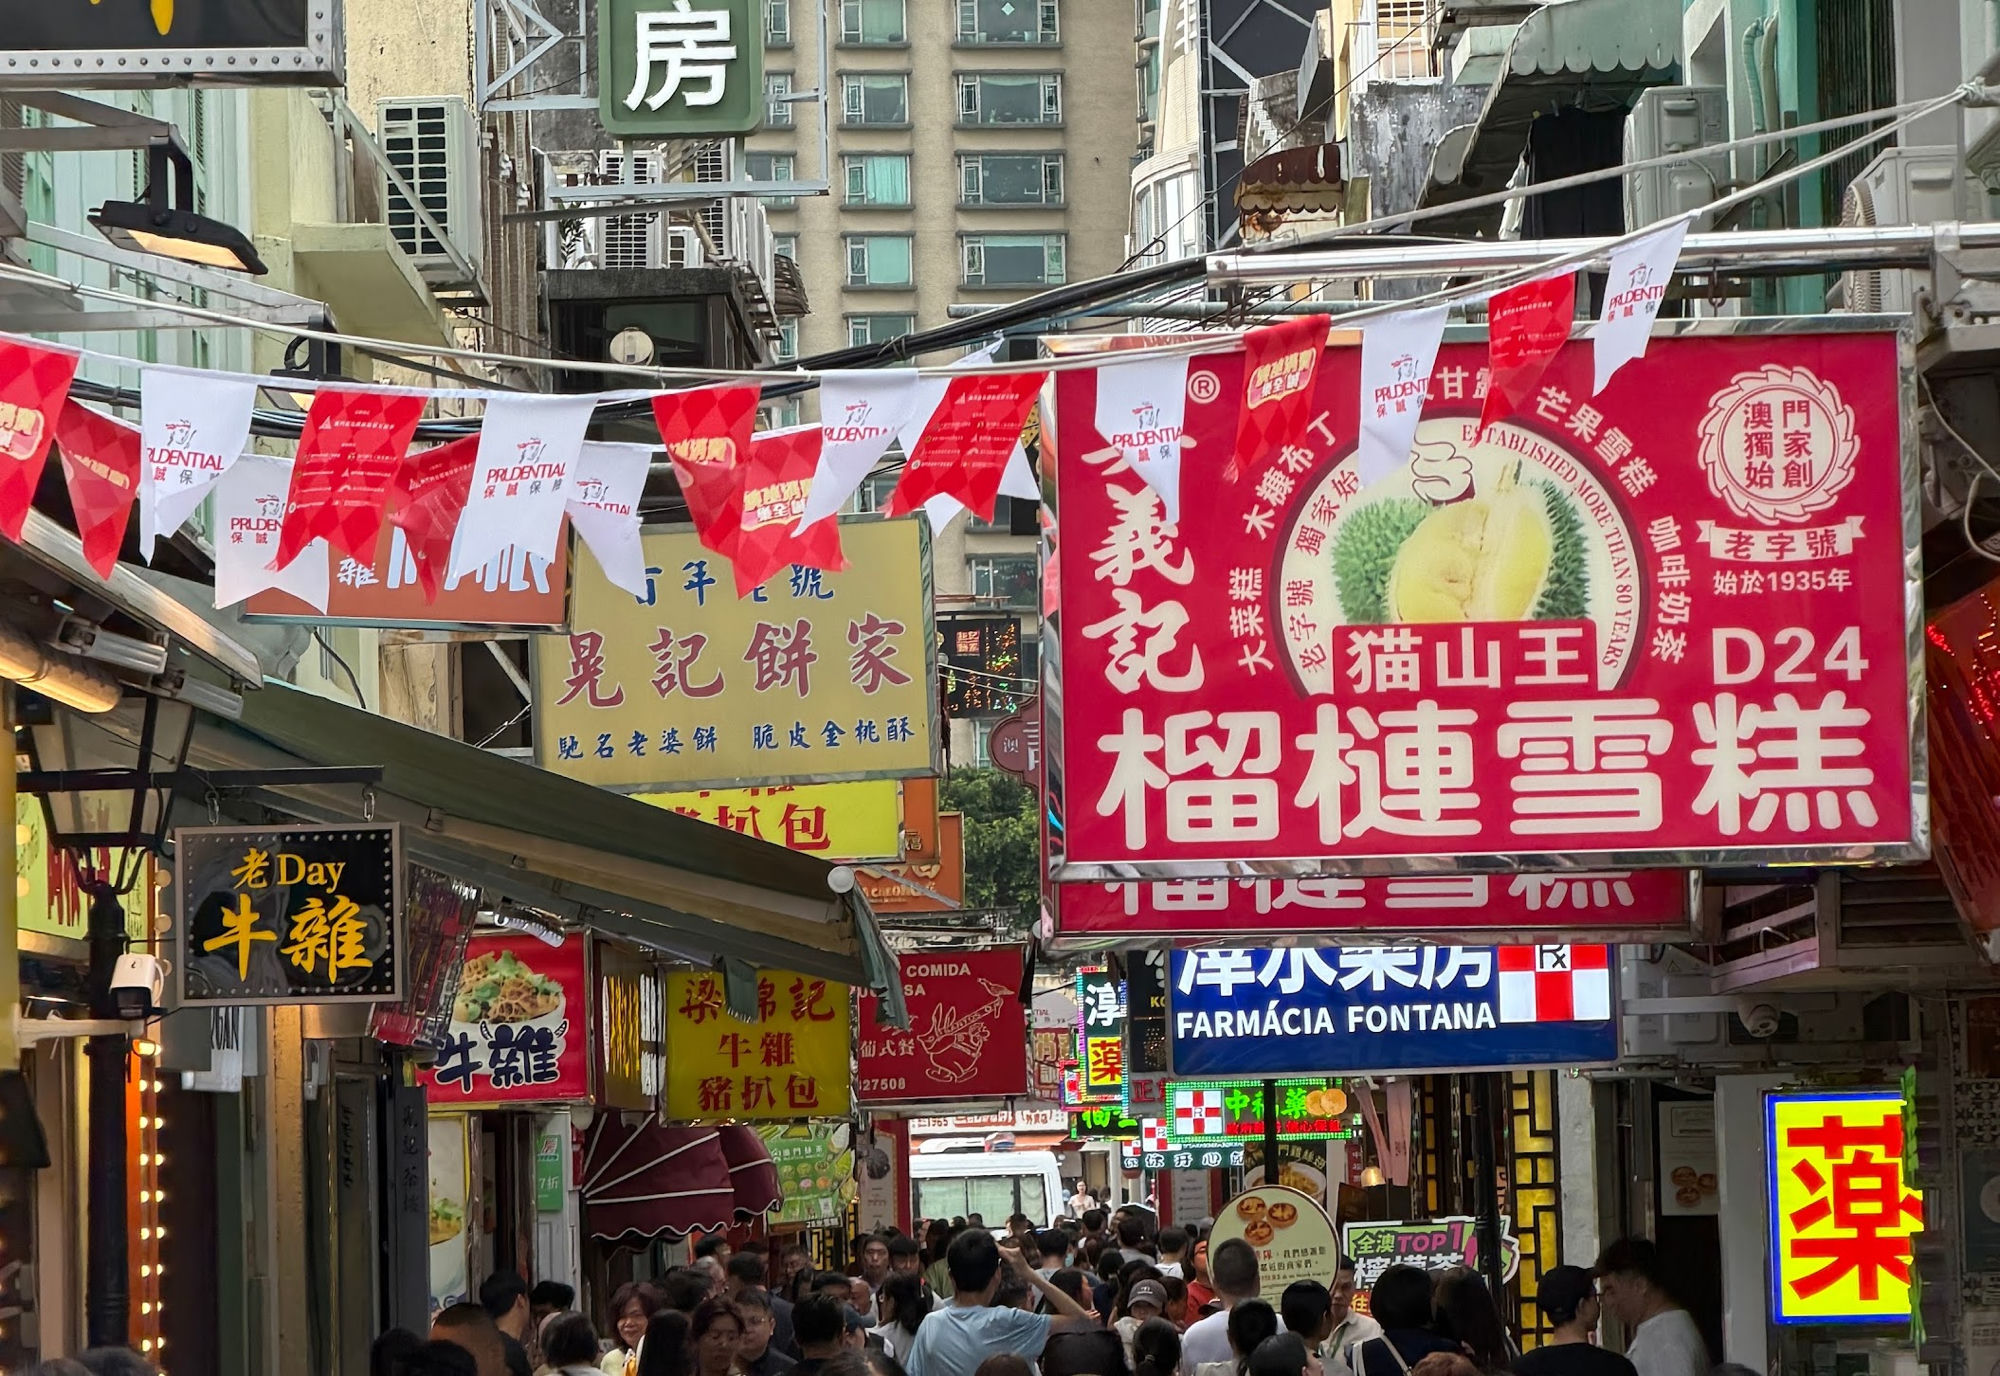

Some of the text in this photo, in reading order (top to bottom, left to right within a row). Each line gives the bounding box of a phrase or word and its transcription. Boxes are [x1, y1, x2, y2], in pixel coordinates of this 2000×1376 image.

[623, 0, 737, 112] 房
[1744, 400, 1811, 430] 澳門
[1536, 386, 1659, 498] 芒果雪糕
[1744, 431, 1812, 458] 獨家
[487, 462, 566, 484] PRUDENTIAL
[1243, 411, 1336, 540] 木糠布丁
[1744, 461, 1814, 489] 始創
[1574, 479, 1614, 528] MORE
[1603, 527, 1633, 580] THAN
[1724, 530, 1839, 561] 老字號
[1615, 581, 1634, 606] 80
[1647, 515, 1692, 665] 咖啡奶茶
[1713, 568, 1853, 596] 始於1935年
[1228, 567, 1275, 677] 大菜糕
[1287, 580, 1327, 674] 老字號
[1602, 608, 1633, 669] YEARS
[555, 611, 914, 709] 晃記餅家
[1346, 626, 1590, 694] 猫山王
[1711, 626, 1869, 686] D24
[557, 715, 916, 761] 馳名老婆餅 脆皮金桃酥
[1096, 688, 1882, 851] 榴槤雪糕
[202, 892, 374, 985] 牛雜
[906, 963, 972, 978] COMIDA
[1176, 1000, 1497, 1039] FARMÁCIA FONTANA
[718, 1031, 795, 1069] 牛雜
[697, 1073, 820, 1112] 豬扒包
[859, 1078, 906, 1093] 27508
